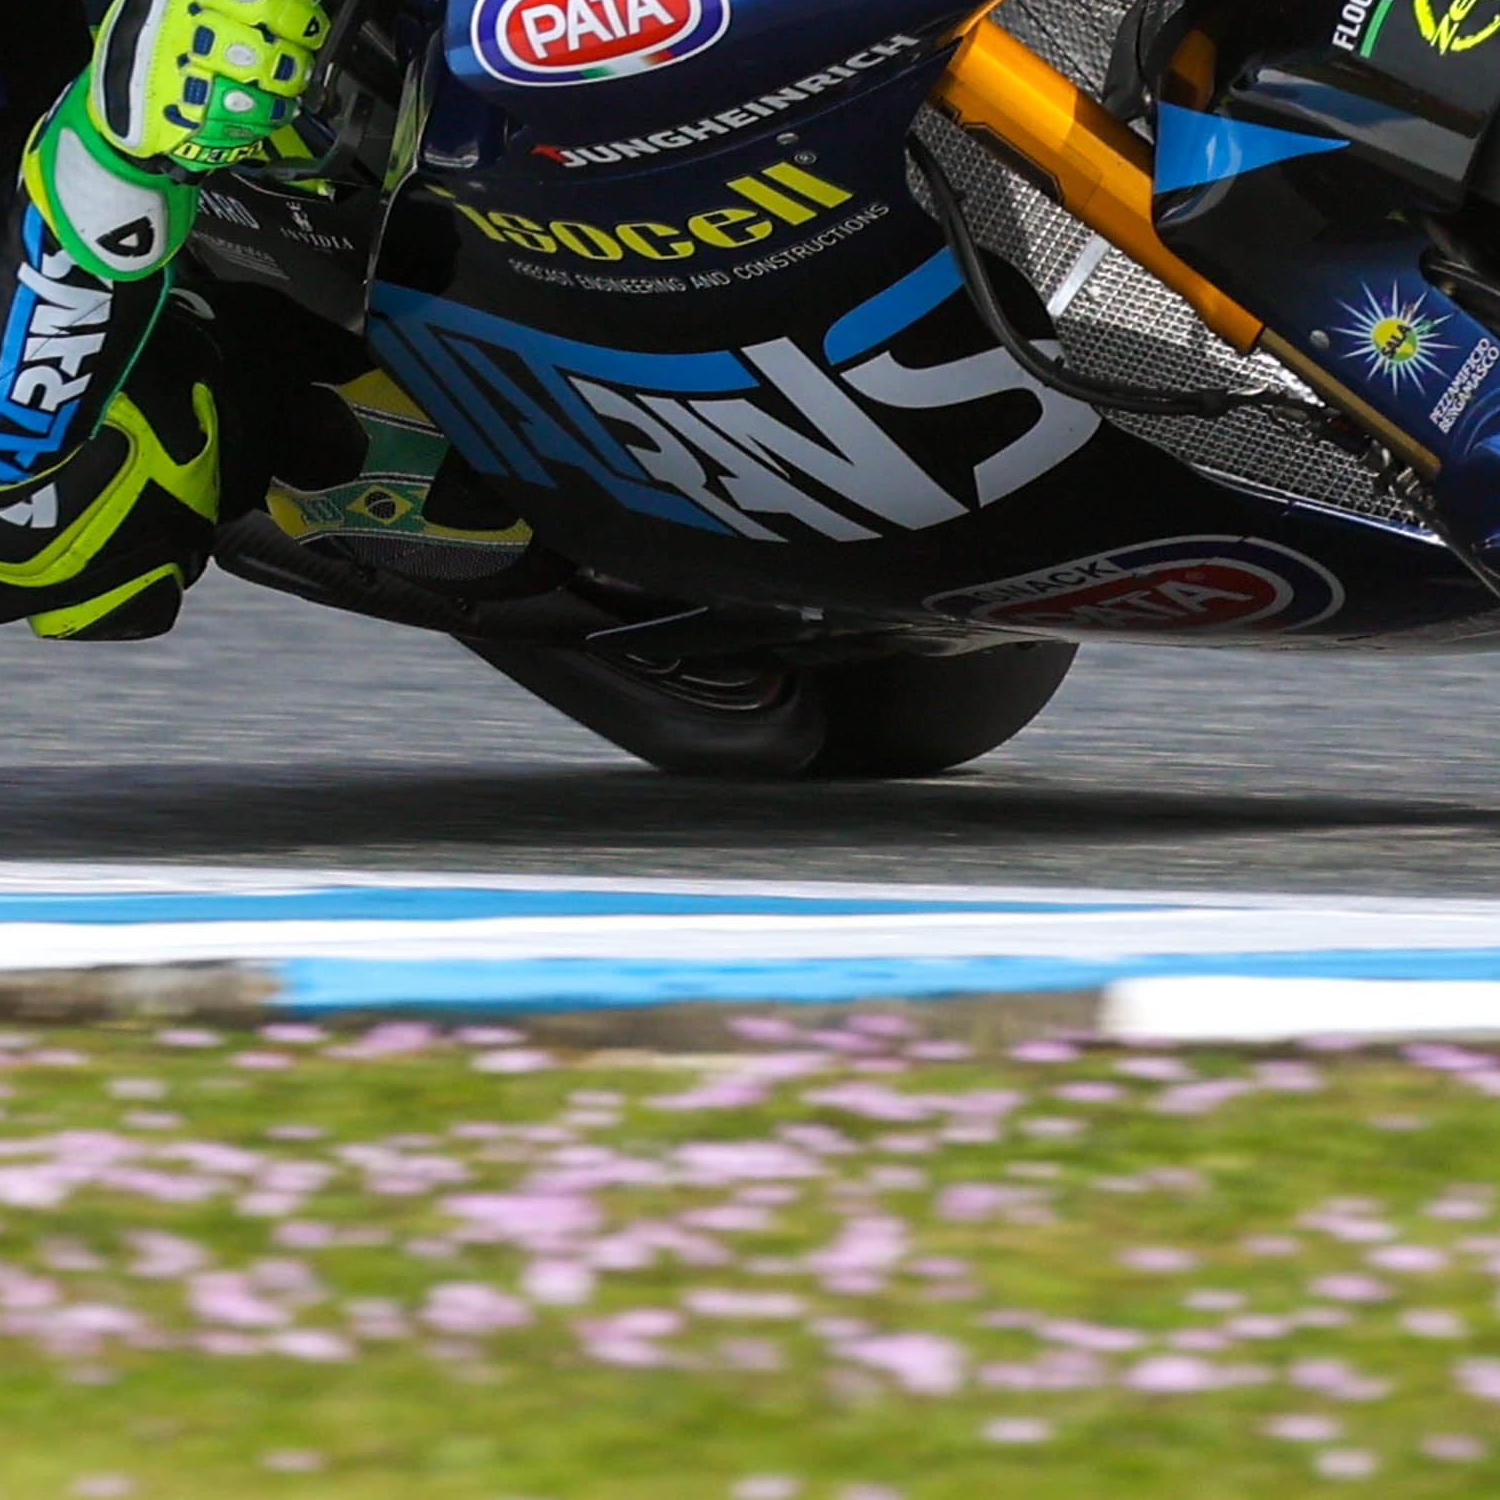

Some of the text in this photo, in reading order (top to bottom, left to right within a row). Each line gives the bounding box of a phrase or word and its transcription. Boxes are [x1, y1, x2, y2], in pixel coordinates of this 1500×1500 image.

[561, 33, 921, 168] JUNGHEINRICH
[691, 273, 732, 291] AND
[735, 202, 890, 282] CONSTRUCTIONS
